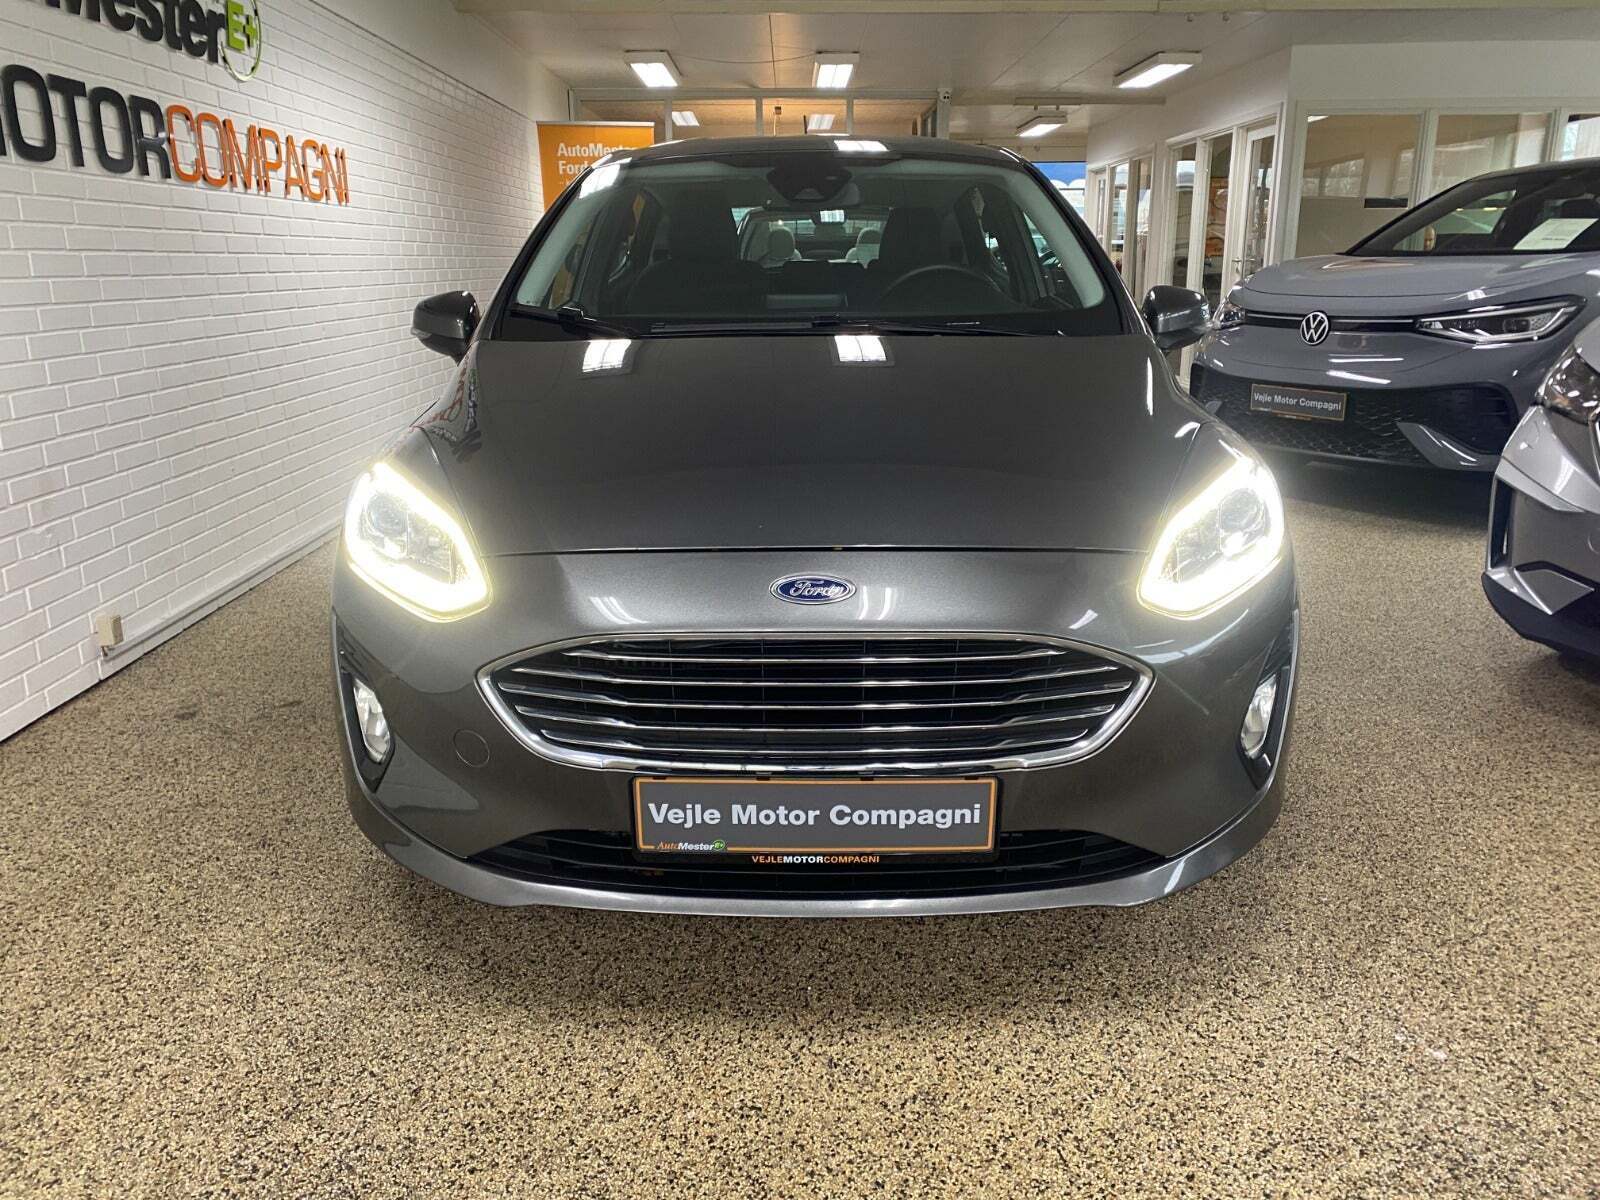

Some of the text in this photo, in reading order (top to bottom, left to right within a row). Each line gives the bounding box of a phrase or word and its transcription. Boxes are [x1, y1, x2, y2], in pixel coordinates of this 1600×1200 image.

[45, 0, 225, 63] ester
[0, 64, 350, 206] OTORCOMPAGNI
[557, 142, 638, 158] AutoMe
[1253, 392, 1342, 411] Vejle Motor Compagni
[789, 580, 844, 596] Ford
[648, 803, 981, 829] Vejle Motor Compagni
